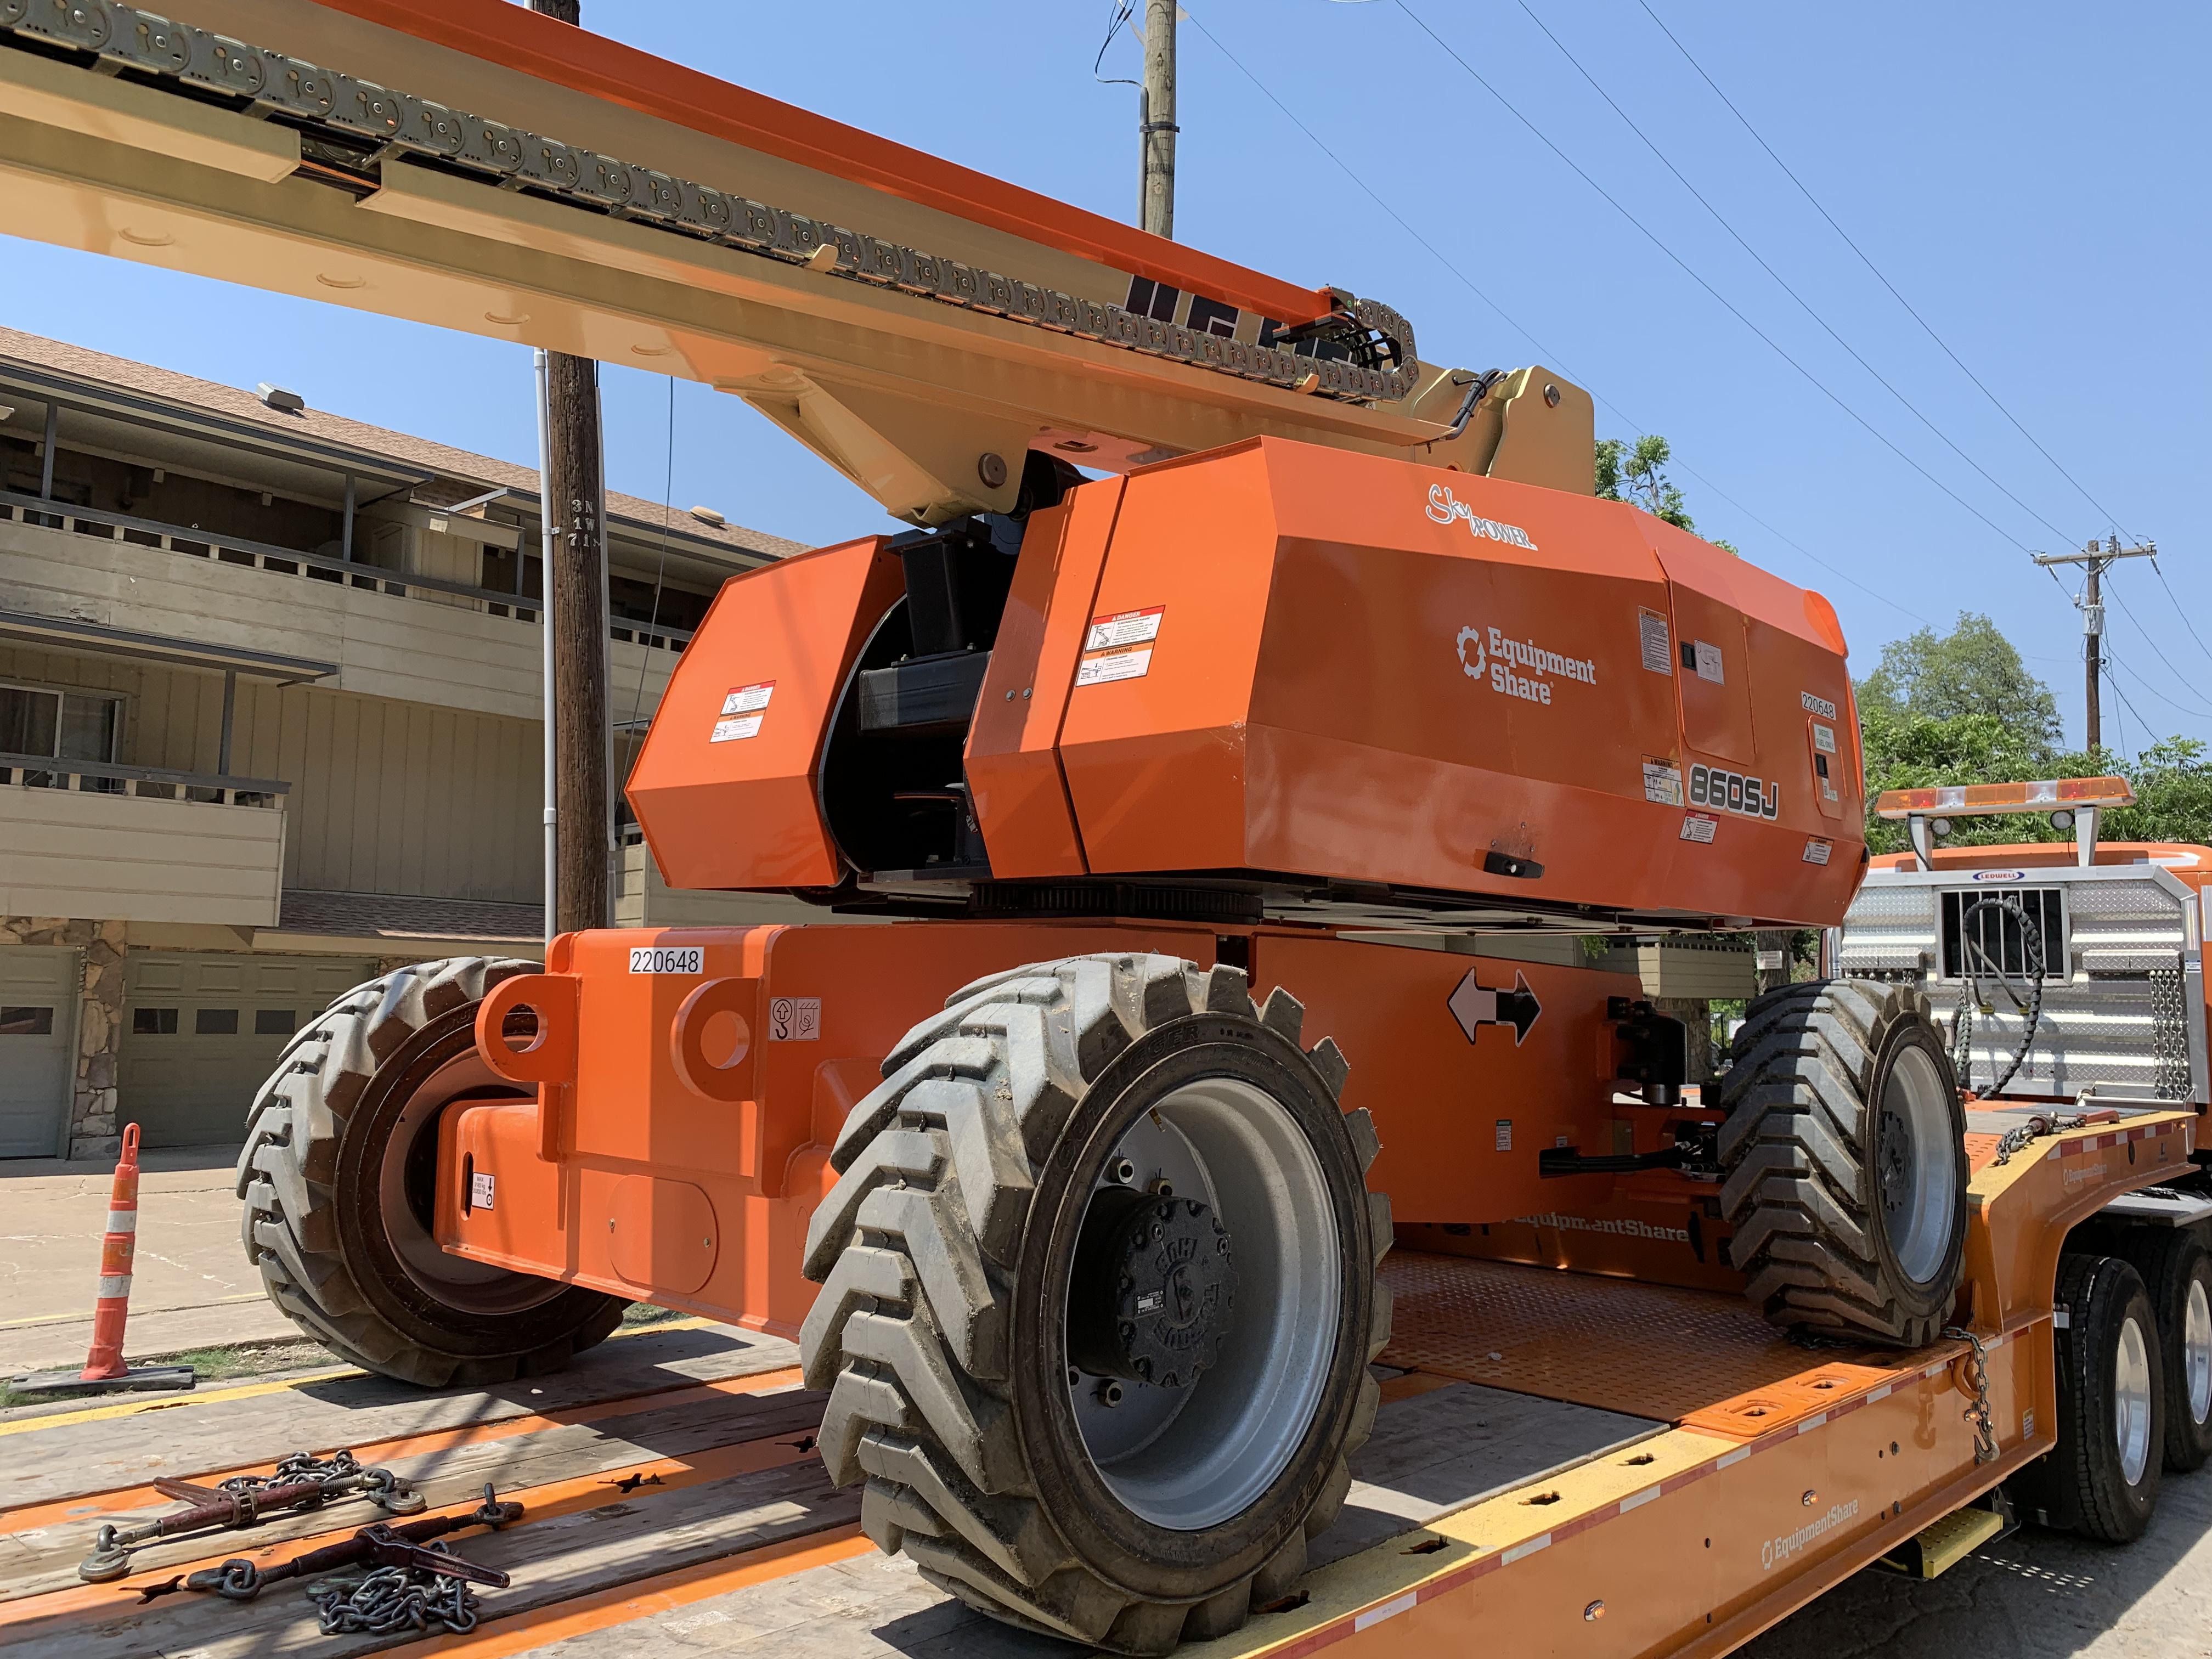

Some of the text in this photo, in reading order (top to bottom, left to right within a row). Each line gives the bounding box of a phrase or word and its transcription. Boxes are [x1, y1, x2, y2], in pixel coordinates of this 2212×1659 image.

[1116, 611, 1141, 620] DANGER
[1105, 647, 1132, 656] WARNING
[1487, 626, 1596, 685] Equipment
[1802, 694, 1835, 719] 220648
[1818, 727, 1830, 738] DIESEL
[1816, 738, 1834, 750] FUEL ONLY
[1689, 763, 1779, 821] 860SJ
[631, 951, 698, 972] 220648
[1774, 1499, 1859, 1559] EquipmentShare
